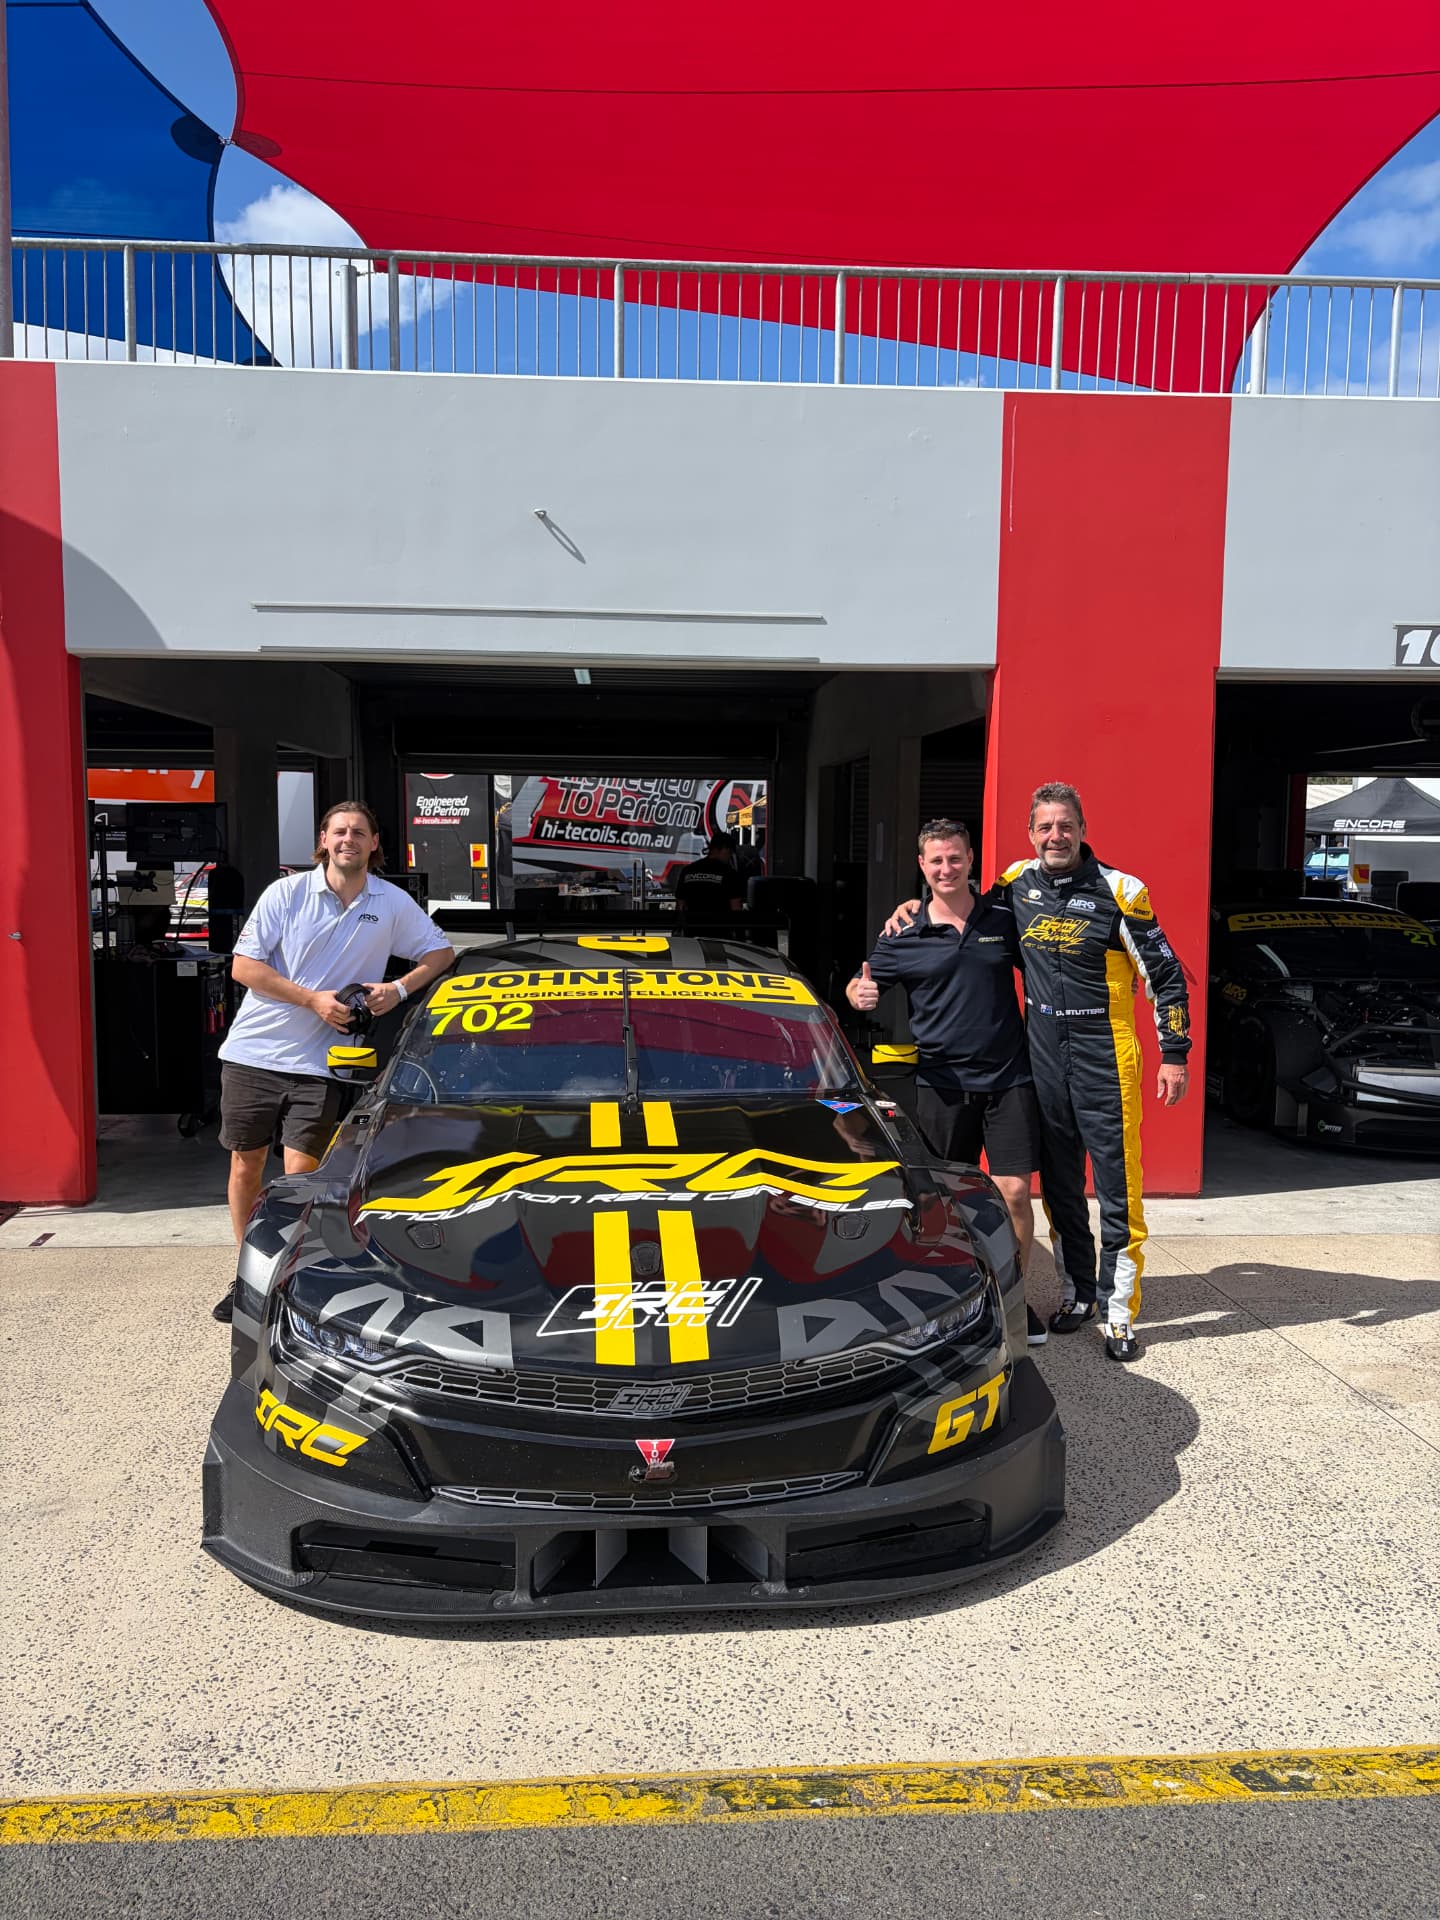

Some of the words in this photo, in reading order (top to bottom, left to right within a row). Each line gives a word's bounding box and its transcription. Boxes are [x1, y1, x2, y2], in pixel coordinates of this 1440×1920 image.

[416, 795, 468, 807] Engineered
[420, 806, 432, 816] To
[432, 805, 470, 816] Perform
[557, 781, 594, 817] To
[596, 787, 700, 828] Perform
[540, 819, 674, 849] hi-tecoils.com.au
[1334, 819, 1406, 829] ENCORE
[1067, 899, 1096, 910] AIRS
[1238, 912, 1418, 925] JOHNSTONE
[451, 971, 792, 991] JOHNSTONE
[501, 991, 598, 999] BUSINESS
[603, 990, 744, 999] INTELLIGENCE
[431, 1002, 533, 1036] 702
[359, 1149, 901, 1212] IRC
[928, 1371, 1006, 1454] GT
[256, 1389, 369, 1467] IRC
